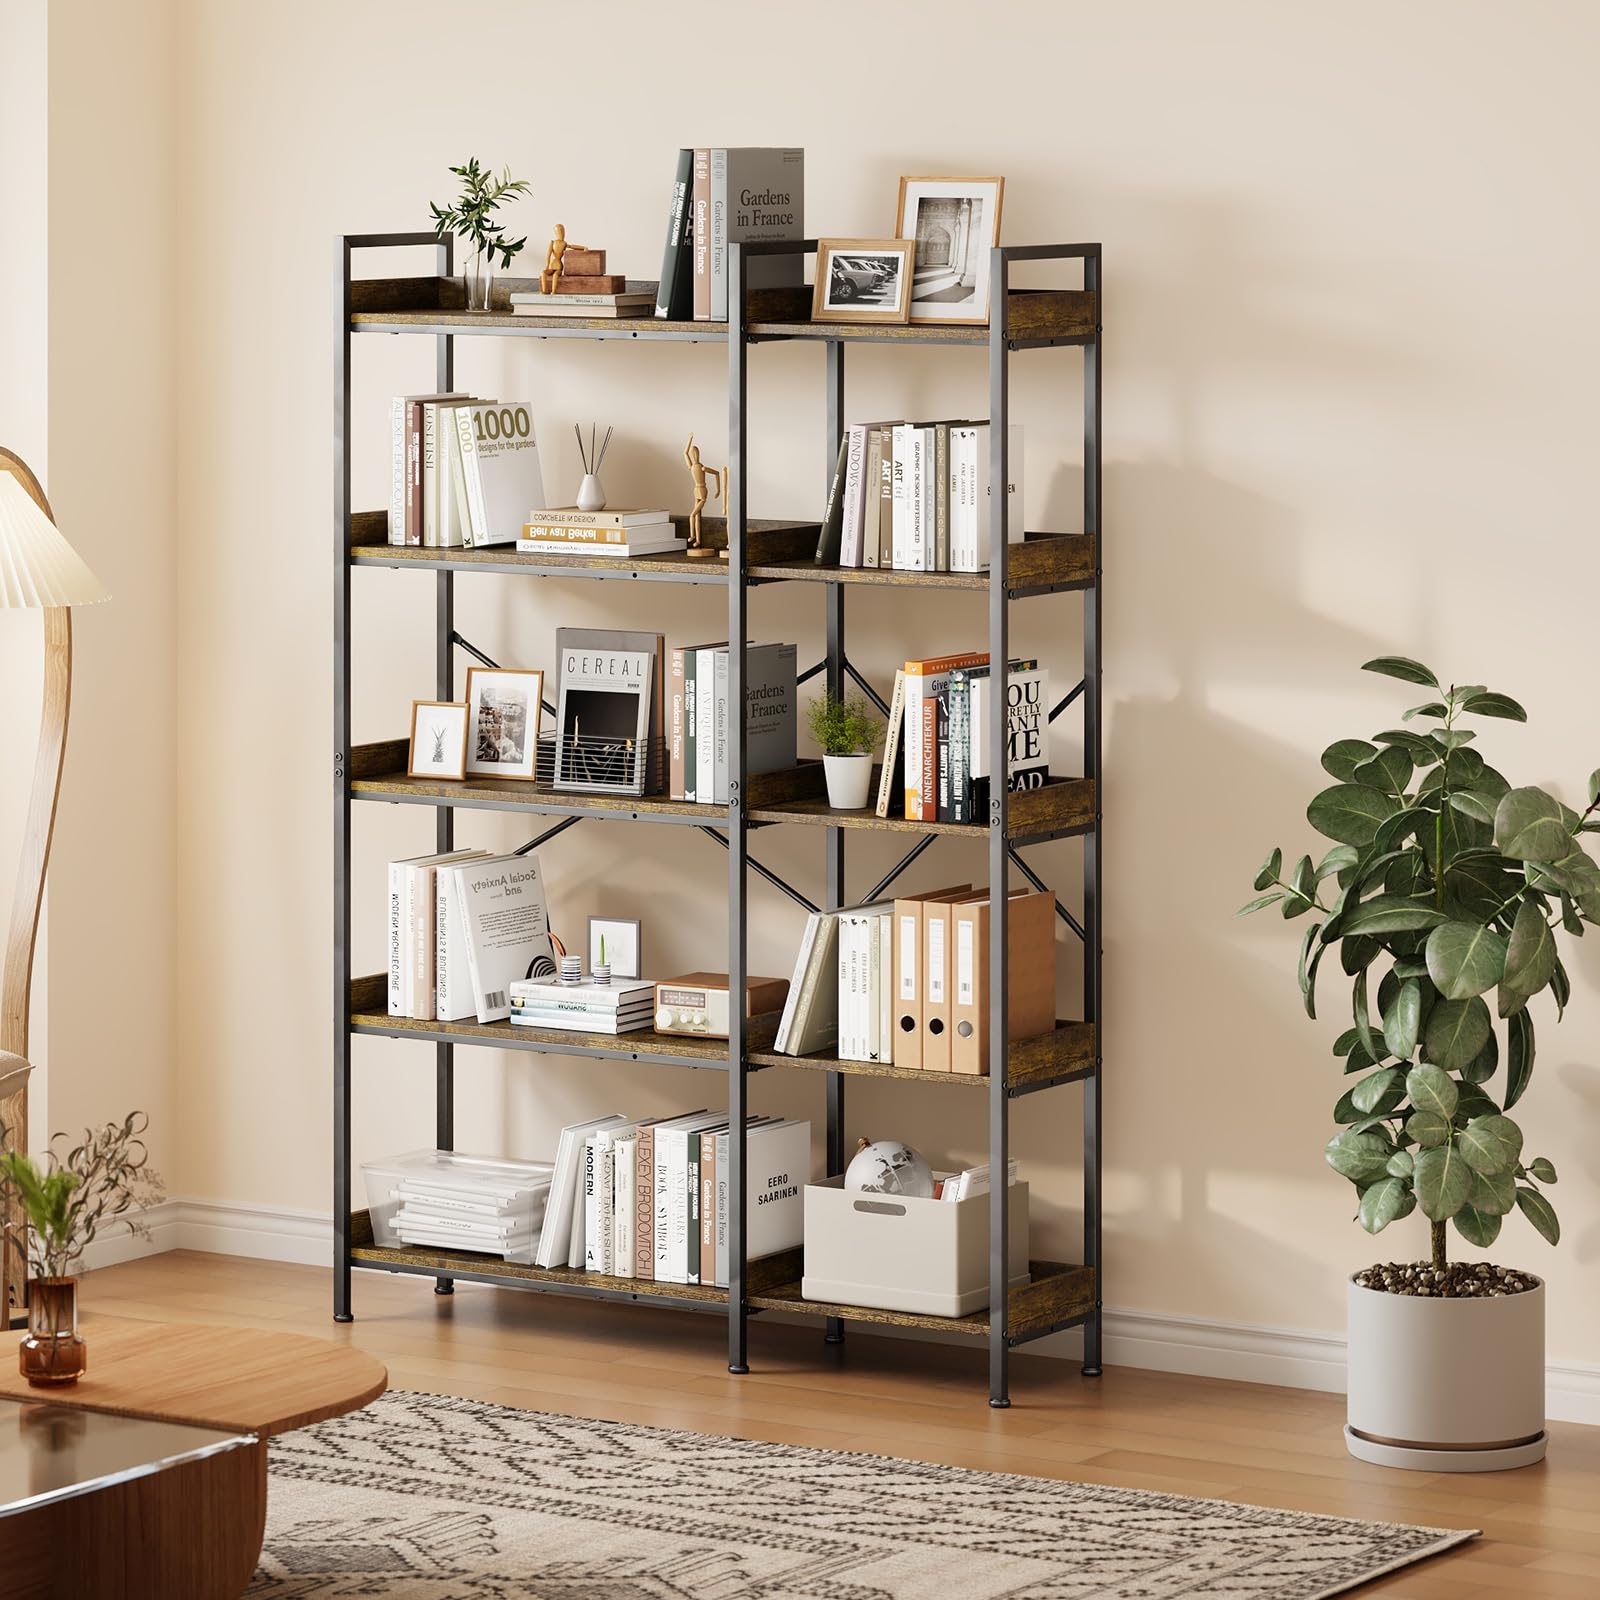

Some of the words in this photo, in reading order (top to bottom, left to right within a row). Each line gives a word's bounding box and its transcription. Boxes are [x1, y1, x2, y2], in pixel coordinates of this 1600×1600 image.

[678, 182, 686, 197] NEW
[740, 189, 791, 207] Gardens
[675, 197, 685, 218] URBAN
[697, 200, 707, 235] Gardens
[714, 200, 723, 235] Gardens
[736, 210, 749, 227] in
[752, 209, 794, 226] France
[671, 219, 681, 247] HOUSING
[697, 236, 706, 244] in
[697, 246, 706, 274] France
[714, 246, 723, 275] France
[458, 413, 473, 453] 1000
[473, 407, 531, 441] 1000
[478, 442, 498, 453] designs
[498, 441, 506, 449] for
[506, 440, 515, 449] the
[515, 440, 536, 450] gardens
[850, 430, 862, 488] WINDOWS
[881, 459, 892, 483] ART
[894, 460, 903, 482] ART
[567, 656, 642, 677] CEREAL
[931, 680, 949, 692] Give
[1007, 680, 1041, 708] OU
[673, 694, 681, 725] Gardens
[718, 698, 726, 728] Gardens
[751, 702, 788, 719] France
[1008, 703, 1042, 717] RETLY
[1008, 713, 1041, 732] ANT
[718, 729, 725, 737] in
[673, 735, 681, 760] France
[923, 705, 932, 804] INNENARCHITEKTUR
[939, 744, 948, 777] GRAVITY'S
[939, 777, 948, 808] RAINBOW
[1008, 771, 1044, 793] EAD
[638, 1130, 652, 1183] ALEXEY
[586, 1145, 594, 1196] MODERN
[604, 1161, 612, 1193] JANG?
[657, 1165, 667, 1195] BOOK
[767, 1174, 789, 1188] EERO
[703, 1179, 712, 1210] Gardens
[718, 1181, 726, 1211] Gardens
[758, 1185, 798, 1205] SAARINEN
[604, 1195, 612, 1237] MICHAEL
[638, 1185, 652, 1269] BRODOVITCH
[718, 1212, 726, 1220] in
[604, 1238, 612, 1248] IS
[657, 1207, 667, 1260] SYMBOLS
[703, 1219, 712, 1245] France
[718, 1222, 726, 1247] France
[604, 1249, 612, 1275] WHO
